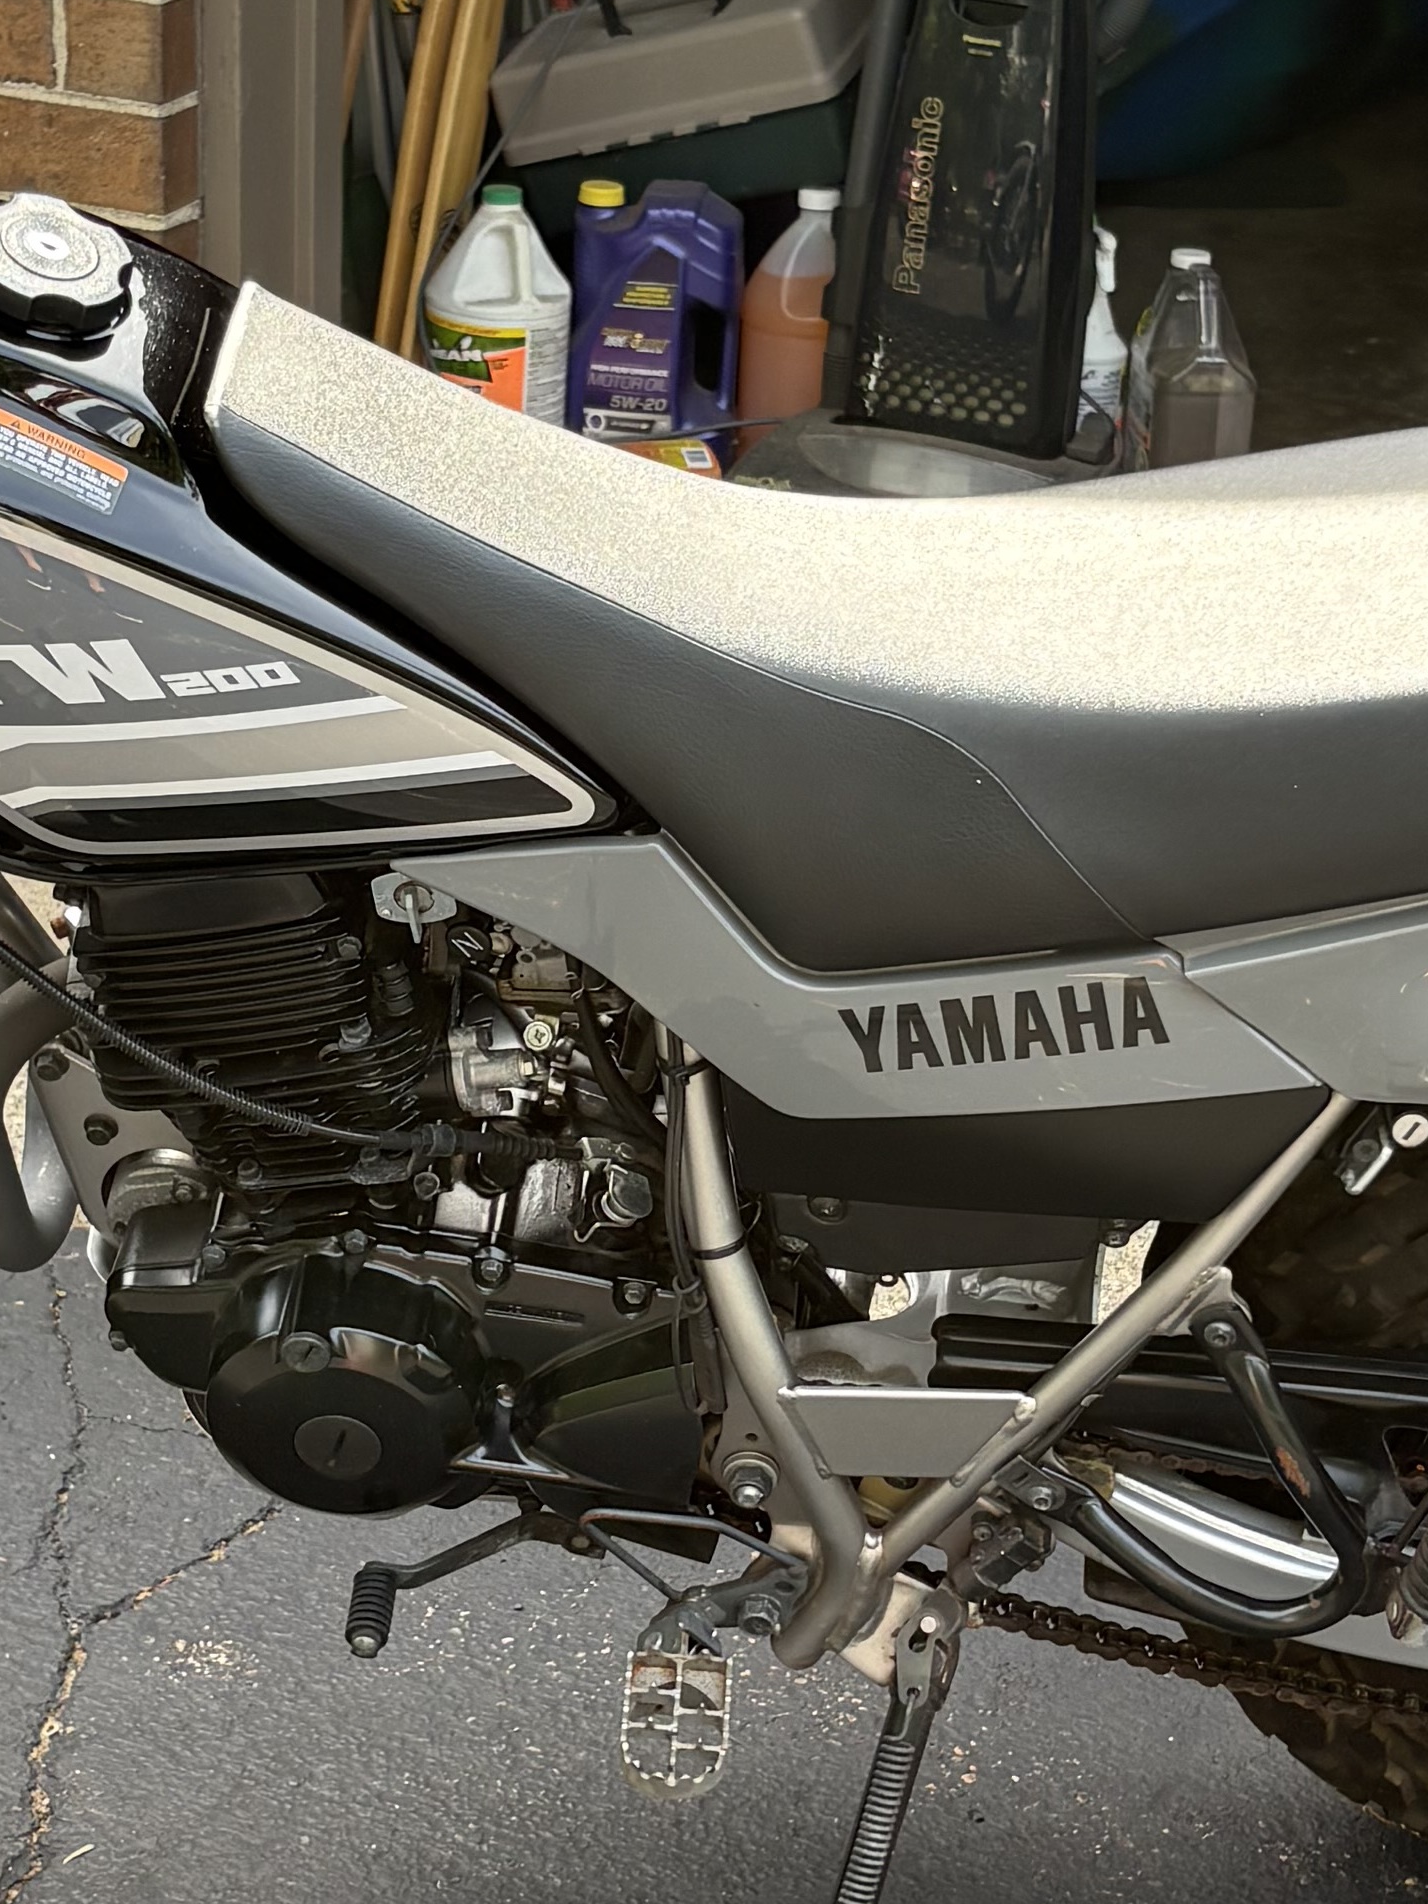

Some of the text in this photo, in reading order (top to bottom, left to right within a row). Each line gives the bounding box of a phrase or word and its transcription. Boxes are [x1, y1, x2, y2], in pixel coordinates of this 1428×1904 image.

[891, 96, 944, 295] Panasonic
[587, 372, 668, 393] MOTOR OIL
[609, 395, 668, 412] 5W-20
[27, 425, 86, 459] WARNING
[160, 661, 301, 697] 200
[837, 976, 1170, 1073] YAMAHA
